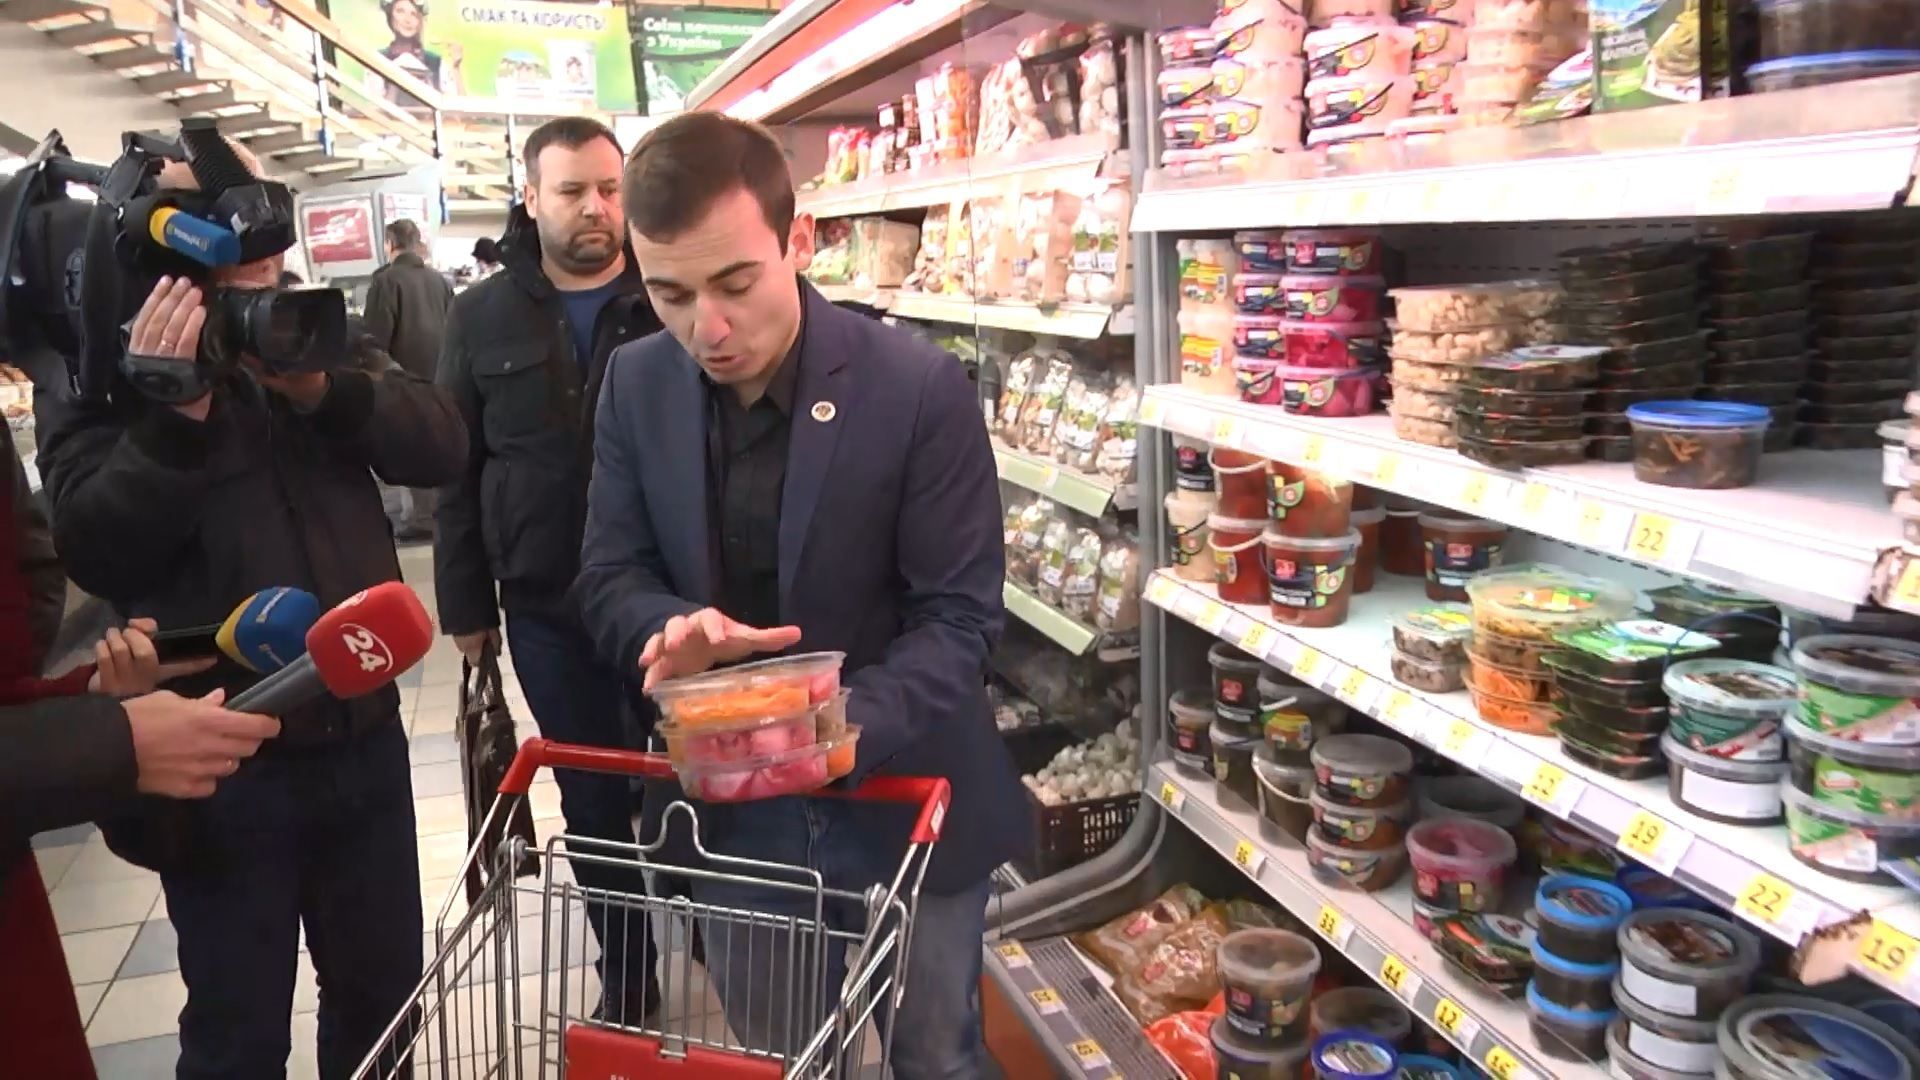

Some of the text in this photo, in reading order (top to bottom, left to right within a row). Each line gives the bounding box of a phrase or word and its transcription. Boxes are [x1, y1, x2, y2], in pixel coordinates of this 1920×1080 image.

[1636, 527, 1665, 552] 22
[342, 629, 387, 672] 24
[1628, 820, 1660, 845] 19
[1747, 882, 1783, 913] 22
[1863, 936, 1907, 971] 19
[1437, 1005, 1458, 1031] 12
